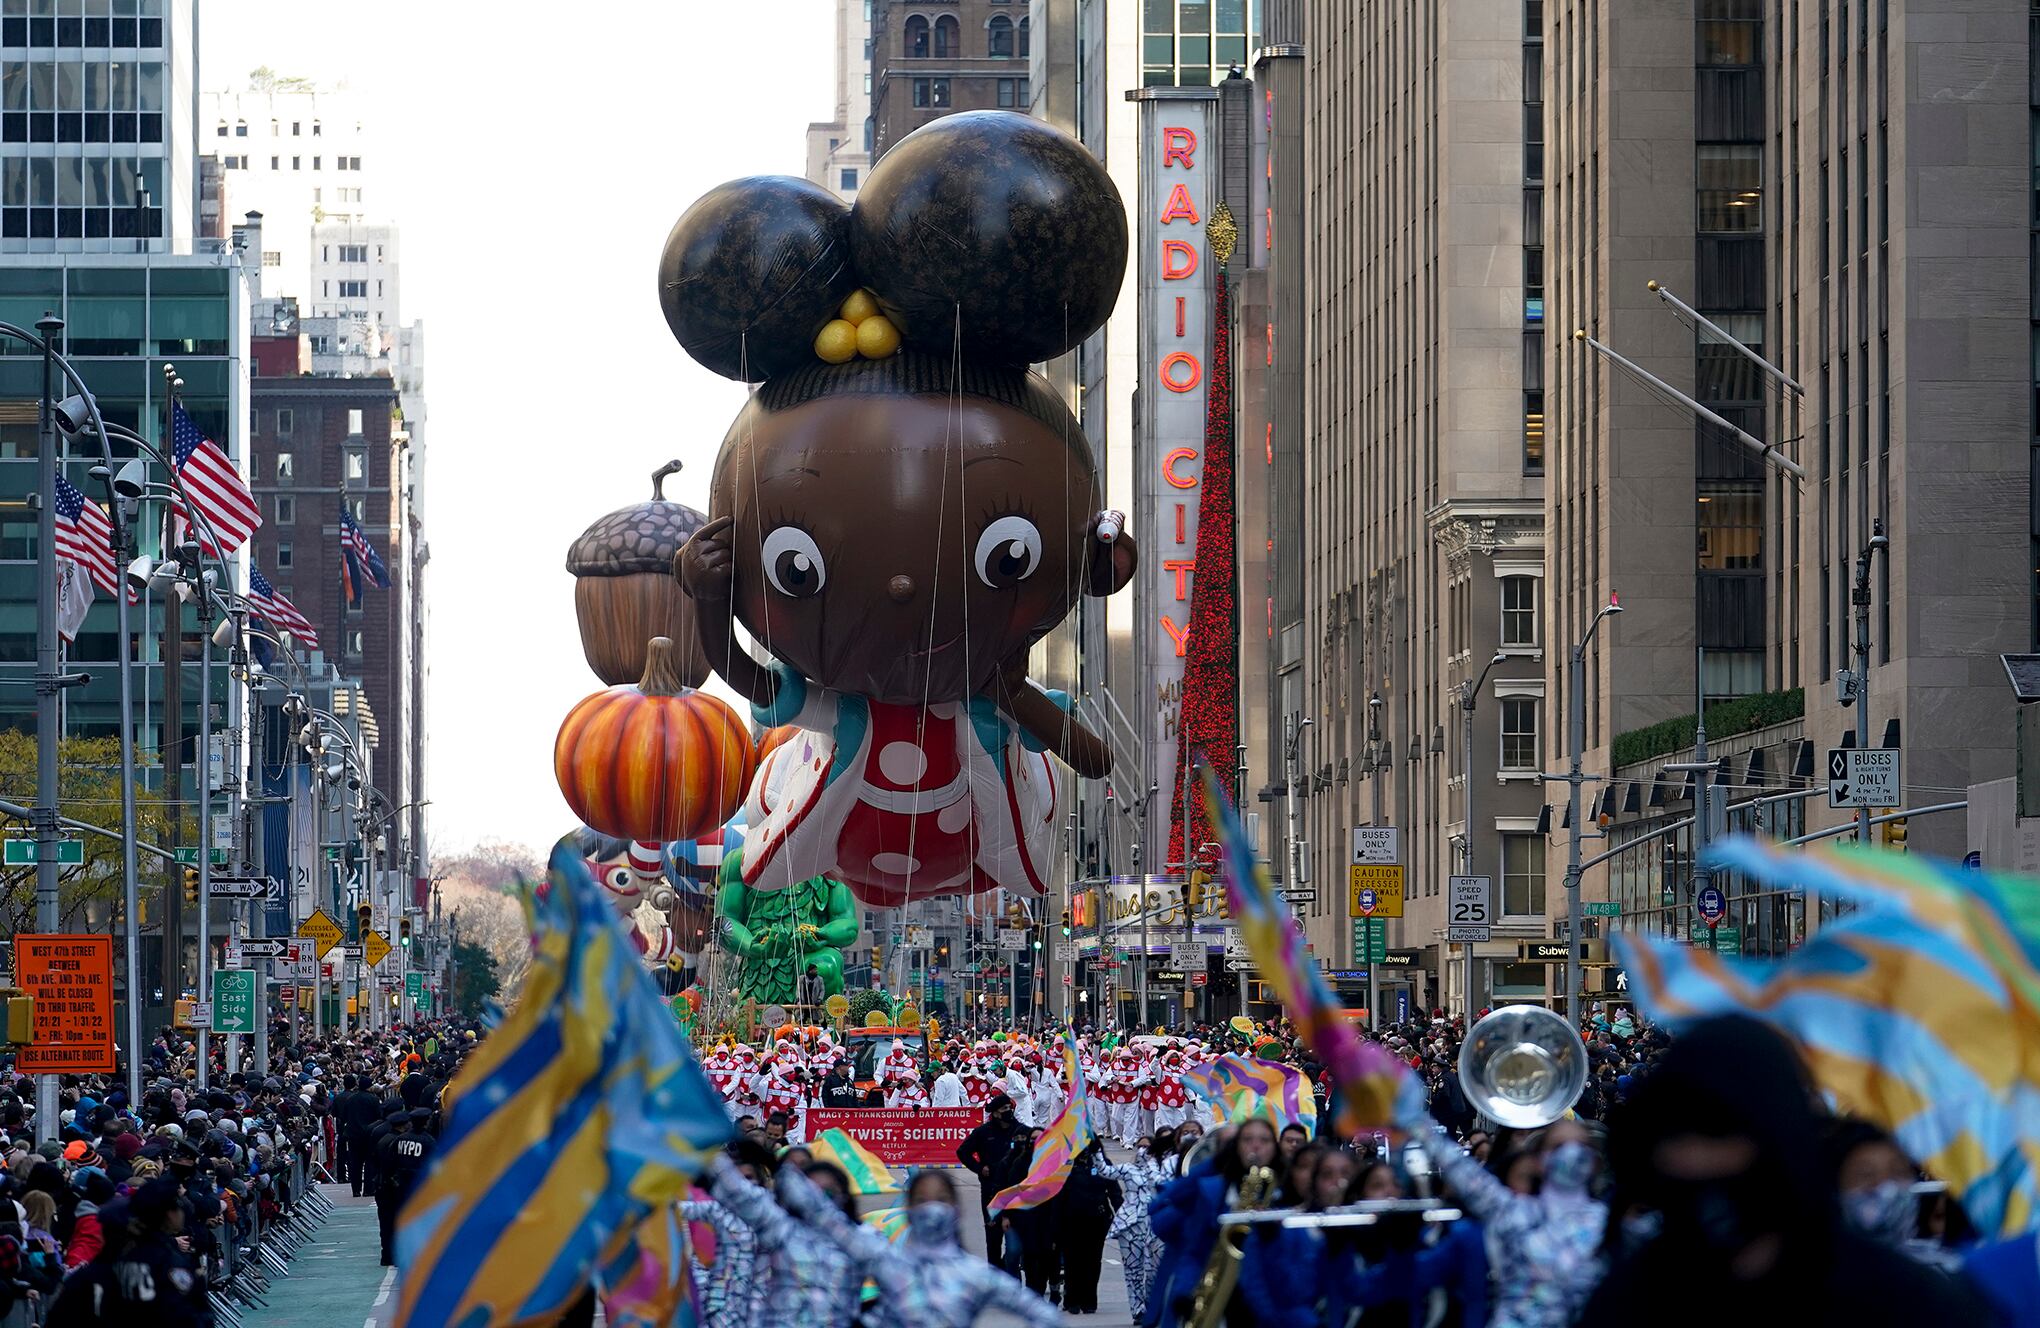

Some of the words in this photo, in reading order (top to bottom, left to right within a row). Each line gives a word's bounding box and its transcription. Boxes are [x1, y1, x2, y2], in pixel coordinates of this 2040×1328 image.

[1160, 127, 1202, 393] RADIO
[1160, 447, 1198, 657] CITY
[1855, 754, 1891, 765] BUSES
[1858, 774, 1887, 785] ONLY
[1362, 831, 1390, 839] BUSES
[27, 846, 34, 860] W
[177, 850, 186, 860] W
[1354, 868, 1398, 877] CAUTION
[240, 884, 258, 892] WAY
[1454, 903, 1486, 922] 25
[1592, 904, 1598, 914] W
[1600, 904, 1610, 914] 48
[32, 946, 52, 957] WEST
[54, 946, 69, 957] 47th
[72, 946, 96, 957] STREET
[1538, 946, 1570, 956] Subwa
[1385, 955, 1410, 964] bway
[48, 960, 80, 970] BETWEEN
[26, 974, 38, 984] 6th
[42, 974, 57, 984] AVE.
[60, 974, 72, 984] AND
[76, 974, 86, 984] 7th
[88, 974, 103, 984] AVE.
[38, 988, 54, 999] WILL
[58, 988, 66, 999] BE
[68, 988, 92, 999] CLOSED
[222, 994, 246, 1002] East
[37, 1002, 45, 1012] TO
[48, 1002, 66, 1012] THRU
[70, 1002, 96, 1012] TRAFFIC
[222, 1004, 246, 1013] Side
[74, 1016, 102, 1027] 1/31/22
[66, 1030, 83, 1042] 10pm
[24, 1050, 38, 1060] USE
[41, 1050, 80, 1060] ALTERNATE
[82, 1050, 104, 1060] ROUTE
[819, 1111, 850, 1119] MACY'S
[854, 1111, 916, 1119] THANKSGIVING
[938, 1110, 970, 1118] PARADE
[850, 1128, 897, 1142] TWIST,
[904, 1128, 974, 1140] SCIENTIST
[398, 1140, 422, 1157] NYPD
